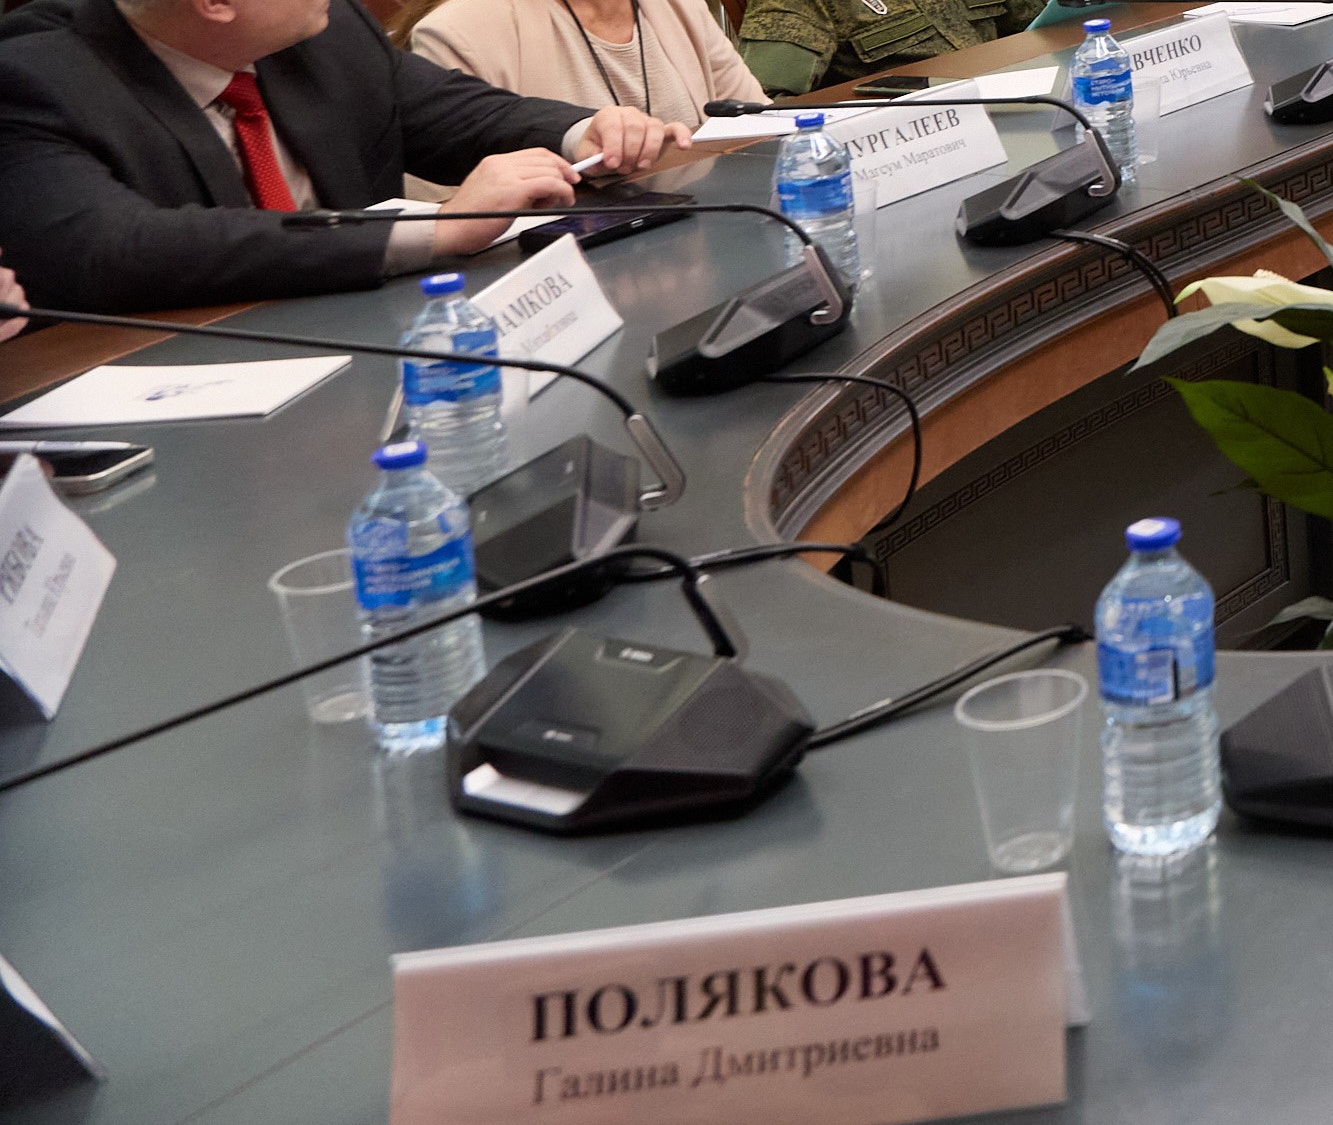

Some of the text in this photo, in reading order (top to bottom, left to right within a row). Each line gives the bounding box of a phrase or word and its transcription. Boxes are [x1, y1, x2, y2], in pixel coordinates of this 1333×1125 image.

[1132, 34, 1202, 71] ВЧЕНКО
[902, 138, 967, 165] Маратович
[529, 947, 948, 1044] ПОЛЯКОВА
[531, 1026, 941, 1106] Галина Дмитриевна
